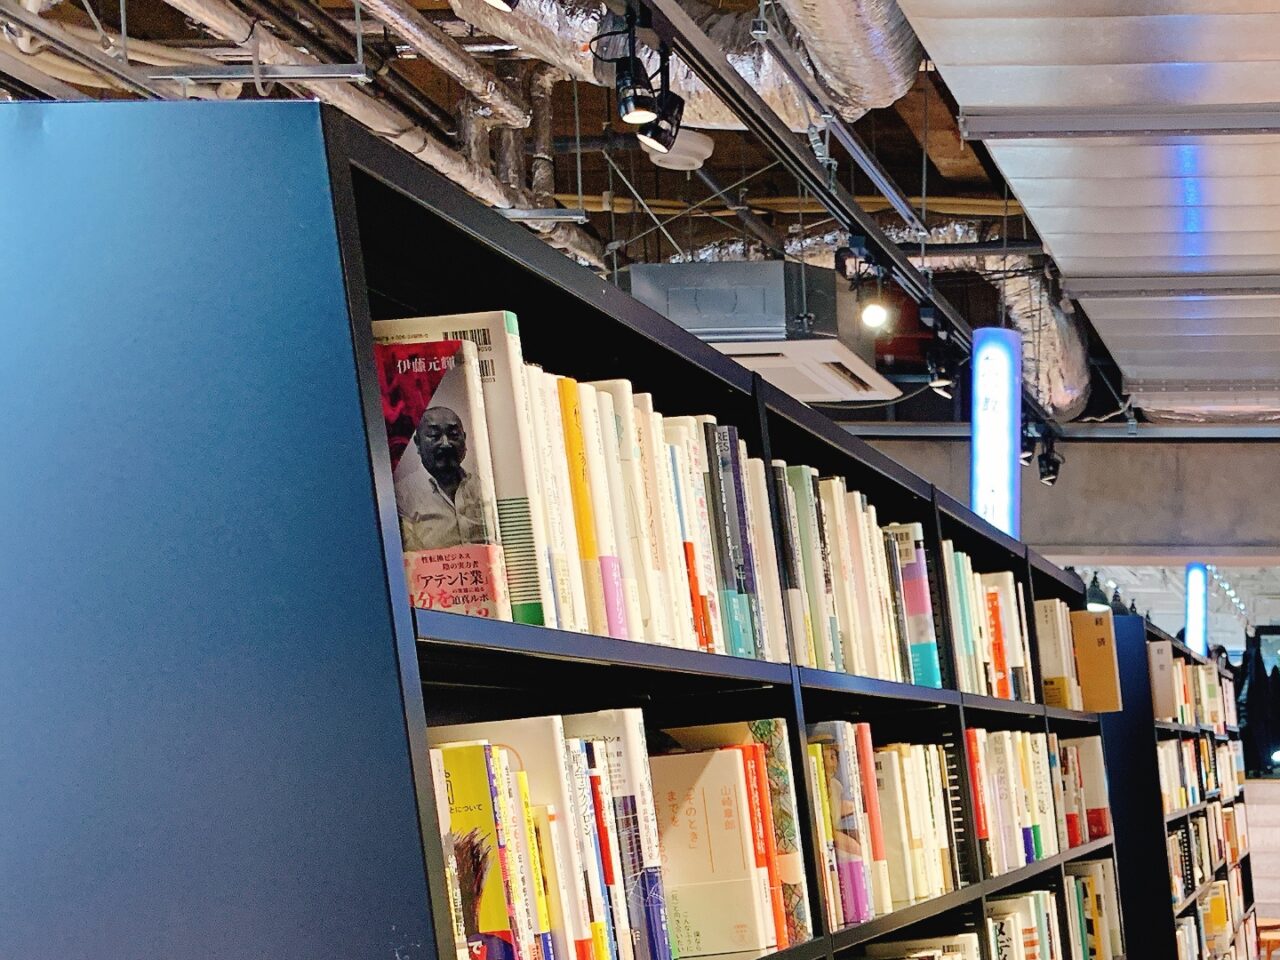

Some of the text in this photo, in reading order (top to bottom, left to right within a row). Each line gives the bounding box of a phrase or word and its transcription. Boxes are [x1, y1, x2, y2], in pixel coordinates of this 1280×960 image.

[397, 355, 456, 374] 伊藤元輝
[416, 569, 489, 589] 「アテンド業」
